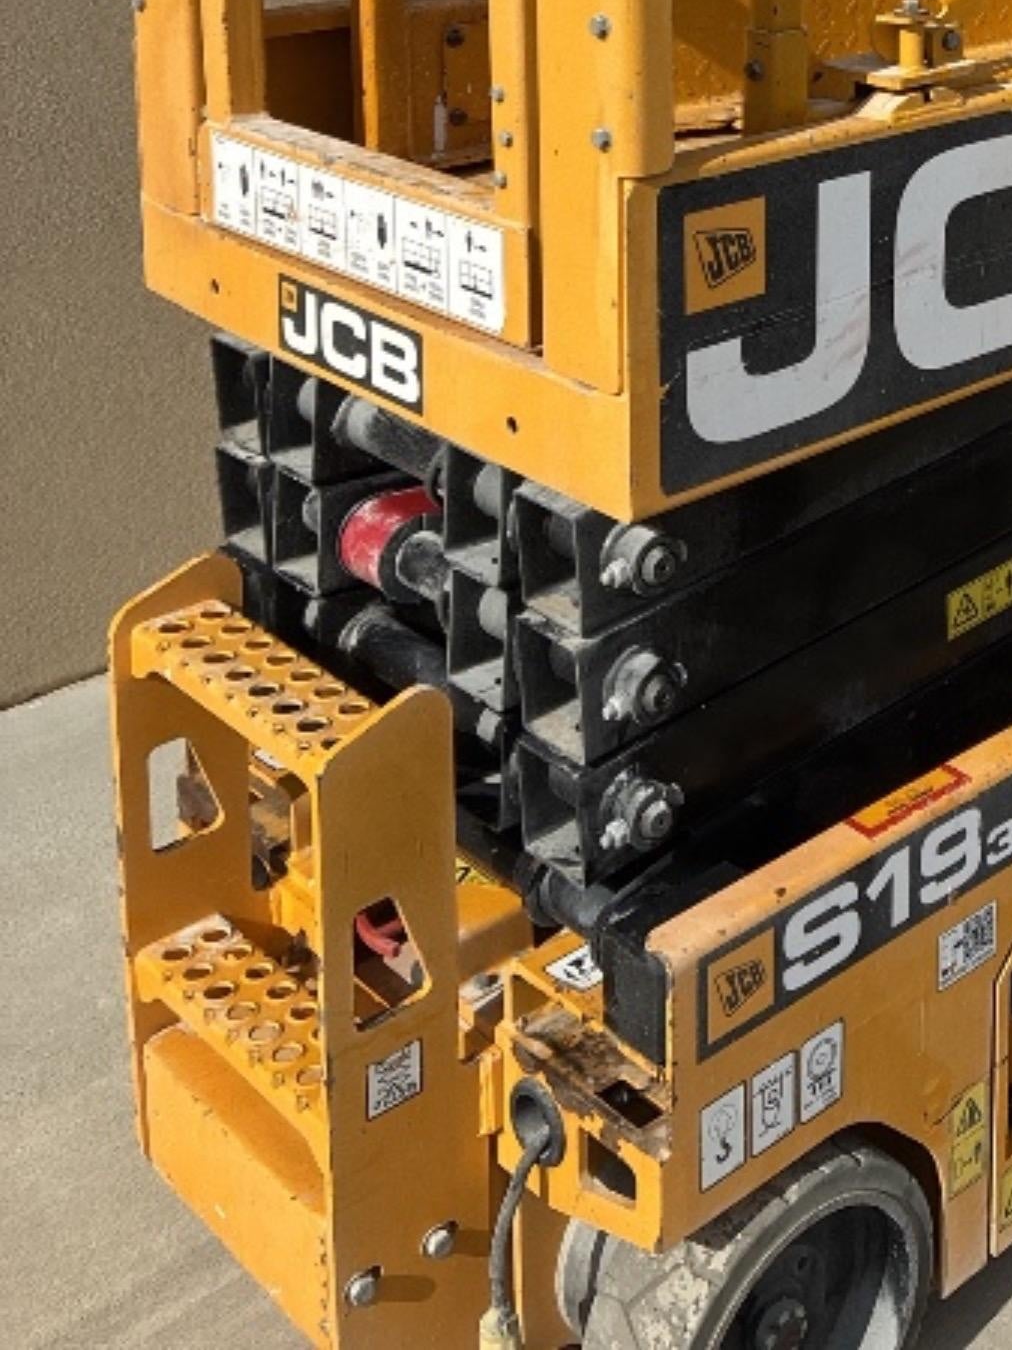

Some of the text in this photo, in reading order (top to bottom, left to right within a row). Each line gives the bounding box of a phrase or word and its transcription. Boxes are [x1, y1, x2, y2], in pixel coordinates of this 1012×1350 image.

[702, 232, 753, 282] JCB
[283, 291, 420, 402] JCB
[723, 961, 764, 1011] JCB
